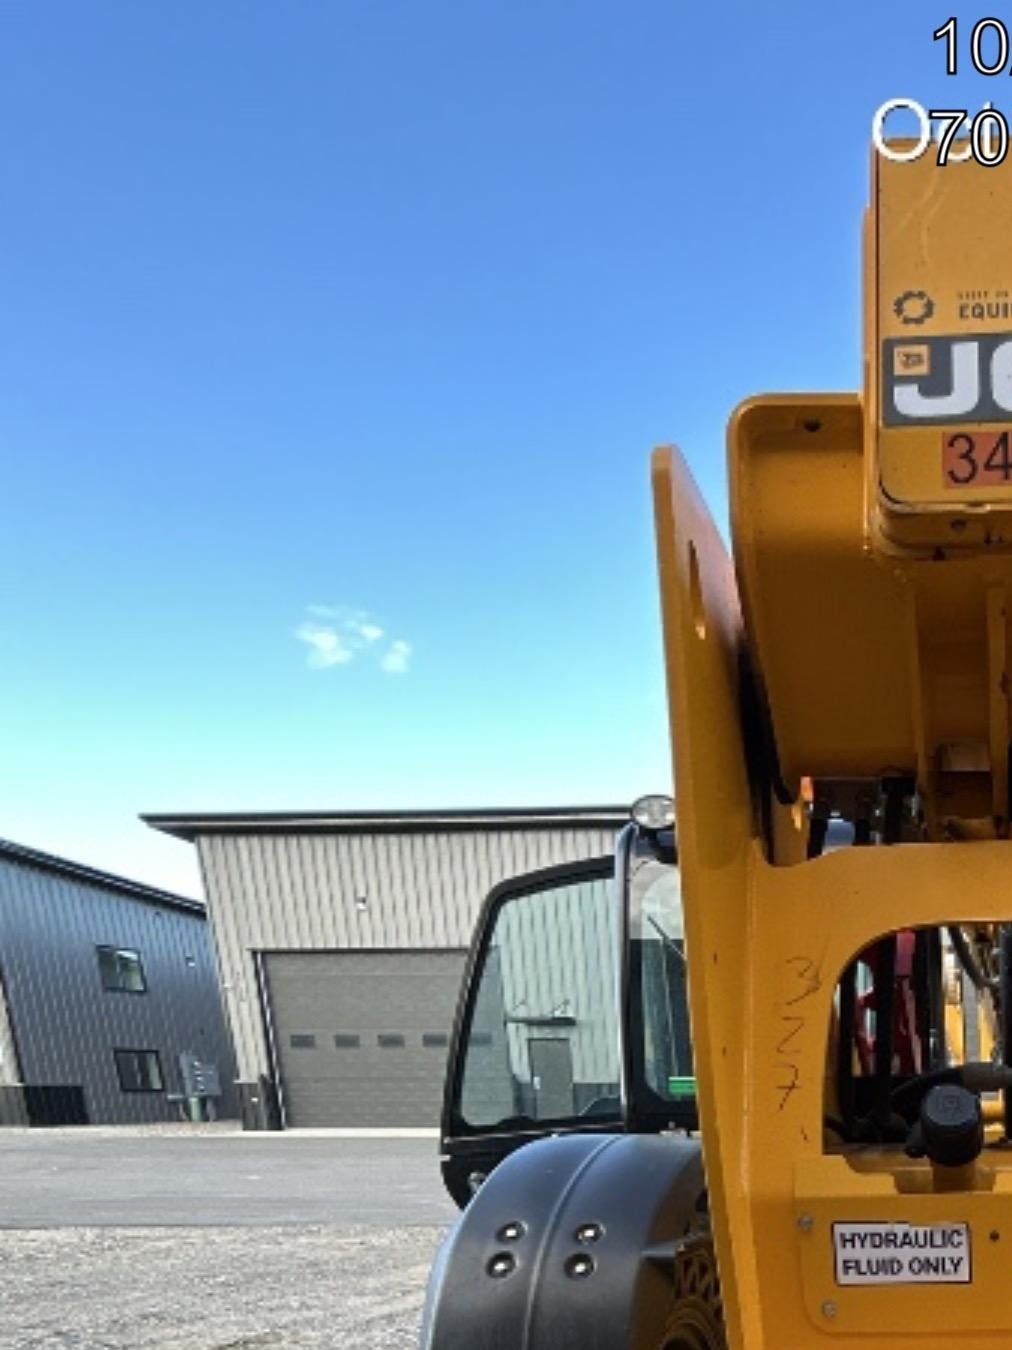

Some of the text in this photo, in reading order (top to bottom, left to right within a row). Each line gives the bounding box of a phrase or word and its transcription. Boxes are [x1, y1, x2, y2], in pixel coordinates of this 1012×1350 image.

[839, 1229, 964, 1249] HYDRAULIC
[842, 1256, 964, 1276] FLUID ONLY
